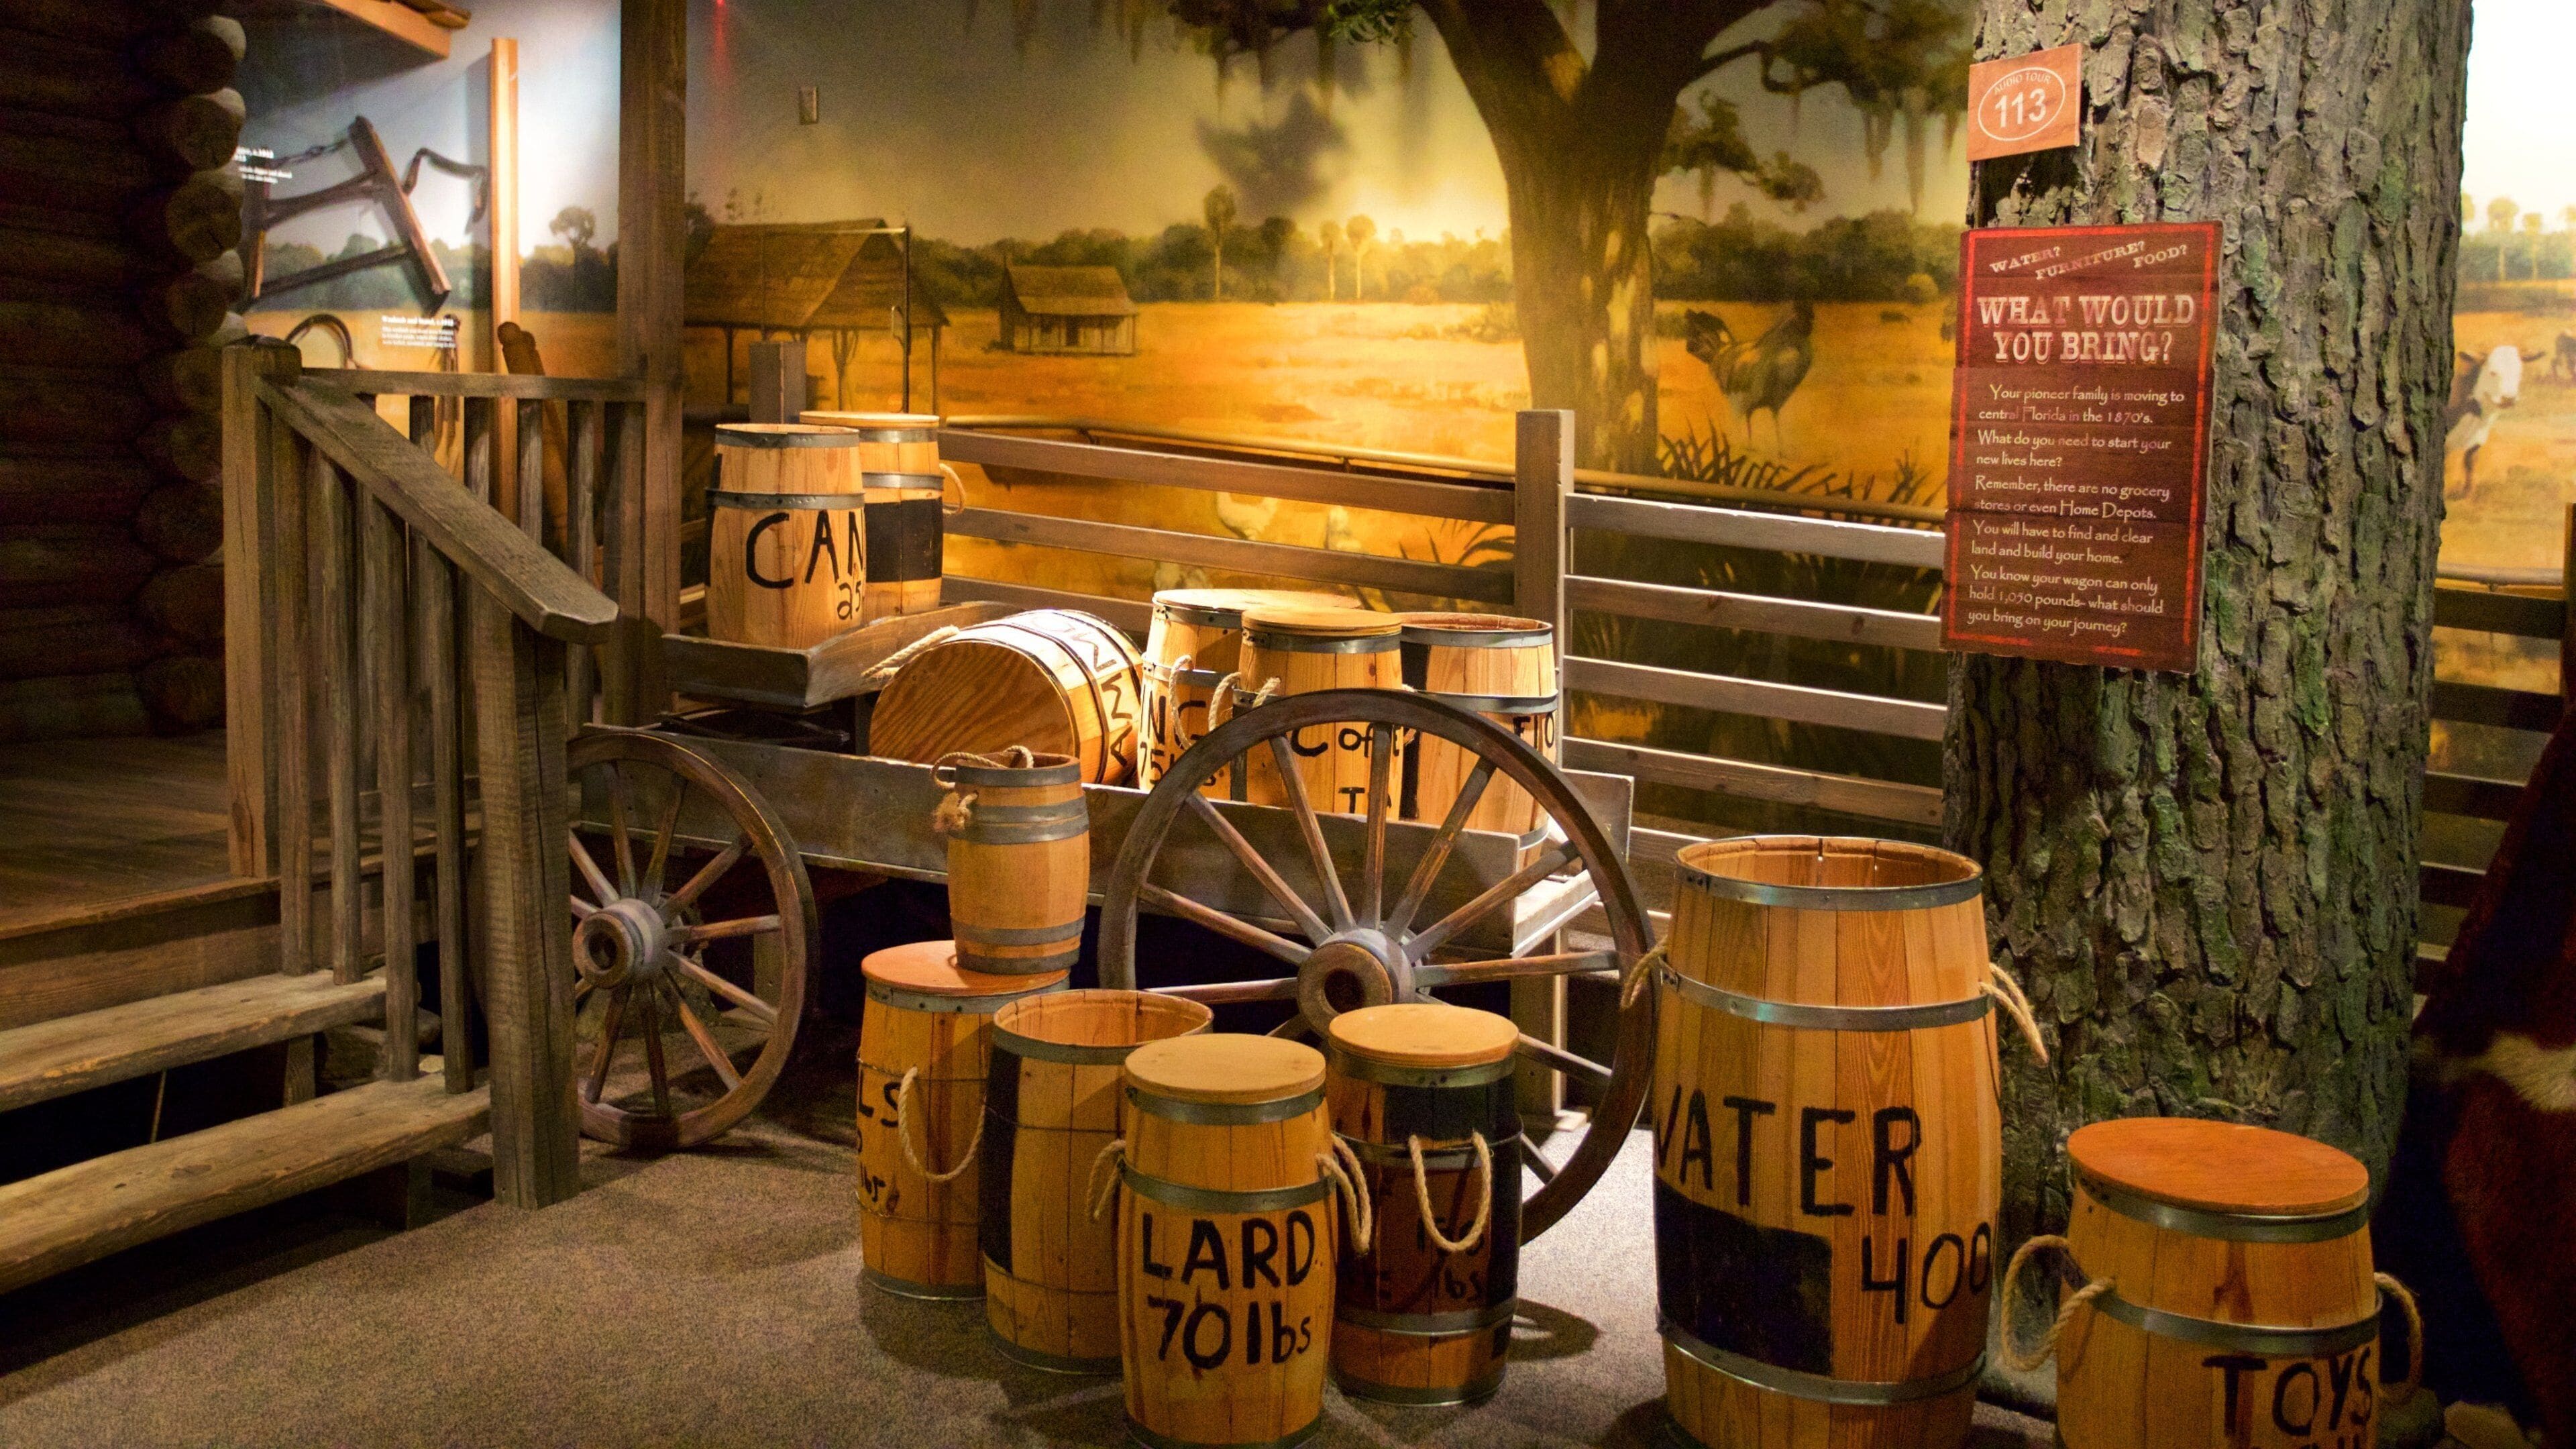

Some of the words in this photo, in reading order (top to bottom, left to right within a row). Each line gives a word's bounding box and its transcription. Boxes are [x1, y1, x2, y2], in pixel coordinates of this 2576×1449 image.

[1993, 74, 2023, 95] AUDIO
[2026, 72, 2051, 85] TOUR
[1995, 88, 2047, 128] 113
[1989, 246, 2061, 274] WATER?
[2035, 240, 2145, 280] FURNITURE?
[2133, 244, 2188, 269] FOOD?
[1976, 296, 2071, 328] WHAT
[2078, 294, 2196, 329] WOULD
[1993, 331, 2053, 364] YOU
[2059, 331, 2174, 365] BRING?
[1990, 384, 2020, 400] Your
[2024, 388, 2070, 404] pioneer
[2072, 385, 2108, 405] family
[2111, 388, 2121, 401] is
[2124, 389, 2168, 407] moving
[2170, 390, 2185, 402] to
[1979, 406, 2019, 421] central
[2022, 406, 2065, 422] Florida
[2069, 409, 2080, 421] in
[2082, 408, 2102, 422] the
[1977, 429, 2012, 445] What
[2014, 431, 2030, 445] do
[2032, 437, 2055, 450] you
[2058, 433, 2088, 447] need
[2092, 436, 2105, 448] to
[2107, 436, 2138, 449] start
[2139, 440, 2172, 454] your
[1976, 455, 1999, 466] new
[2001, 451, 2027, 466] lives
[2029, 451, 2063, 468] here?
[1975, 475, 2041, 494] Remember,
[2043, 477, 2076, 492] there
[2078, 485, 2098, 494] are
[2101, 486, 2117, 495] no
[2118, 486, 2170, 502] grocery
[1974, 499, 2010, 511] stores
[2013, 503, 2027, 512] or
[2029, 504, 2057, 513] even
[2059, 500, 2099, 517] Home
[2102, 502, 2157, 523] Depots.
[1972, 519, 1999, 535] You
[2002, 521, 2019, 536] will
[2022, 522, 2049, 537] have
[2052, 527, 2065, 539] to
[2068, 525, 2092, 540] find
[2095, 527, 2118, 542] and
[2121, 527, 2153, 543] clear
[1972, 540, 1996, 555] land
[1998, 544, 2021, 557] and
[2024, 544, 2053, 559] build
[2055, 551, 2085, 565] your
[2087, 547, 2123, 564] home.
[1970, 564, 1996, 580] You
[2000, 566, 2029, 582] know
[2032, 574, 2061, 588] your
[2063, 577, 2102, 591] wagon
[2105, 580, 2127, 589] can
[2131, 576, 2158, 596] only
[1969, 585, 1994, 600] hold
[2088, 595, 2118, 611] what
[2120, 596, 2163, 614] should
[1968, 610, 1990, 625] you
[1993, 608, 2023, 629] bring
[2025, 616, 2041, 625] on
[2042, 617, 2072, 631] your
[2070, 618, 2127, 638] journey?
[1142, 1210, 1315, 1291] LARD
[1861, 1221, 1992, 1325] 400
[2201, 1346, 2373, 1437] TOYS
